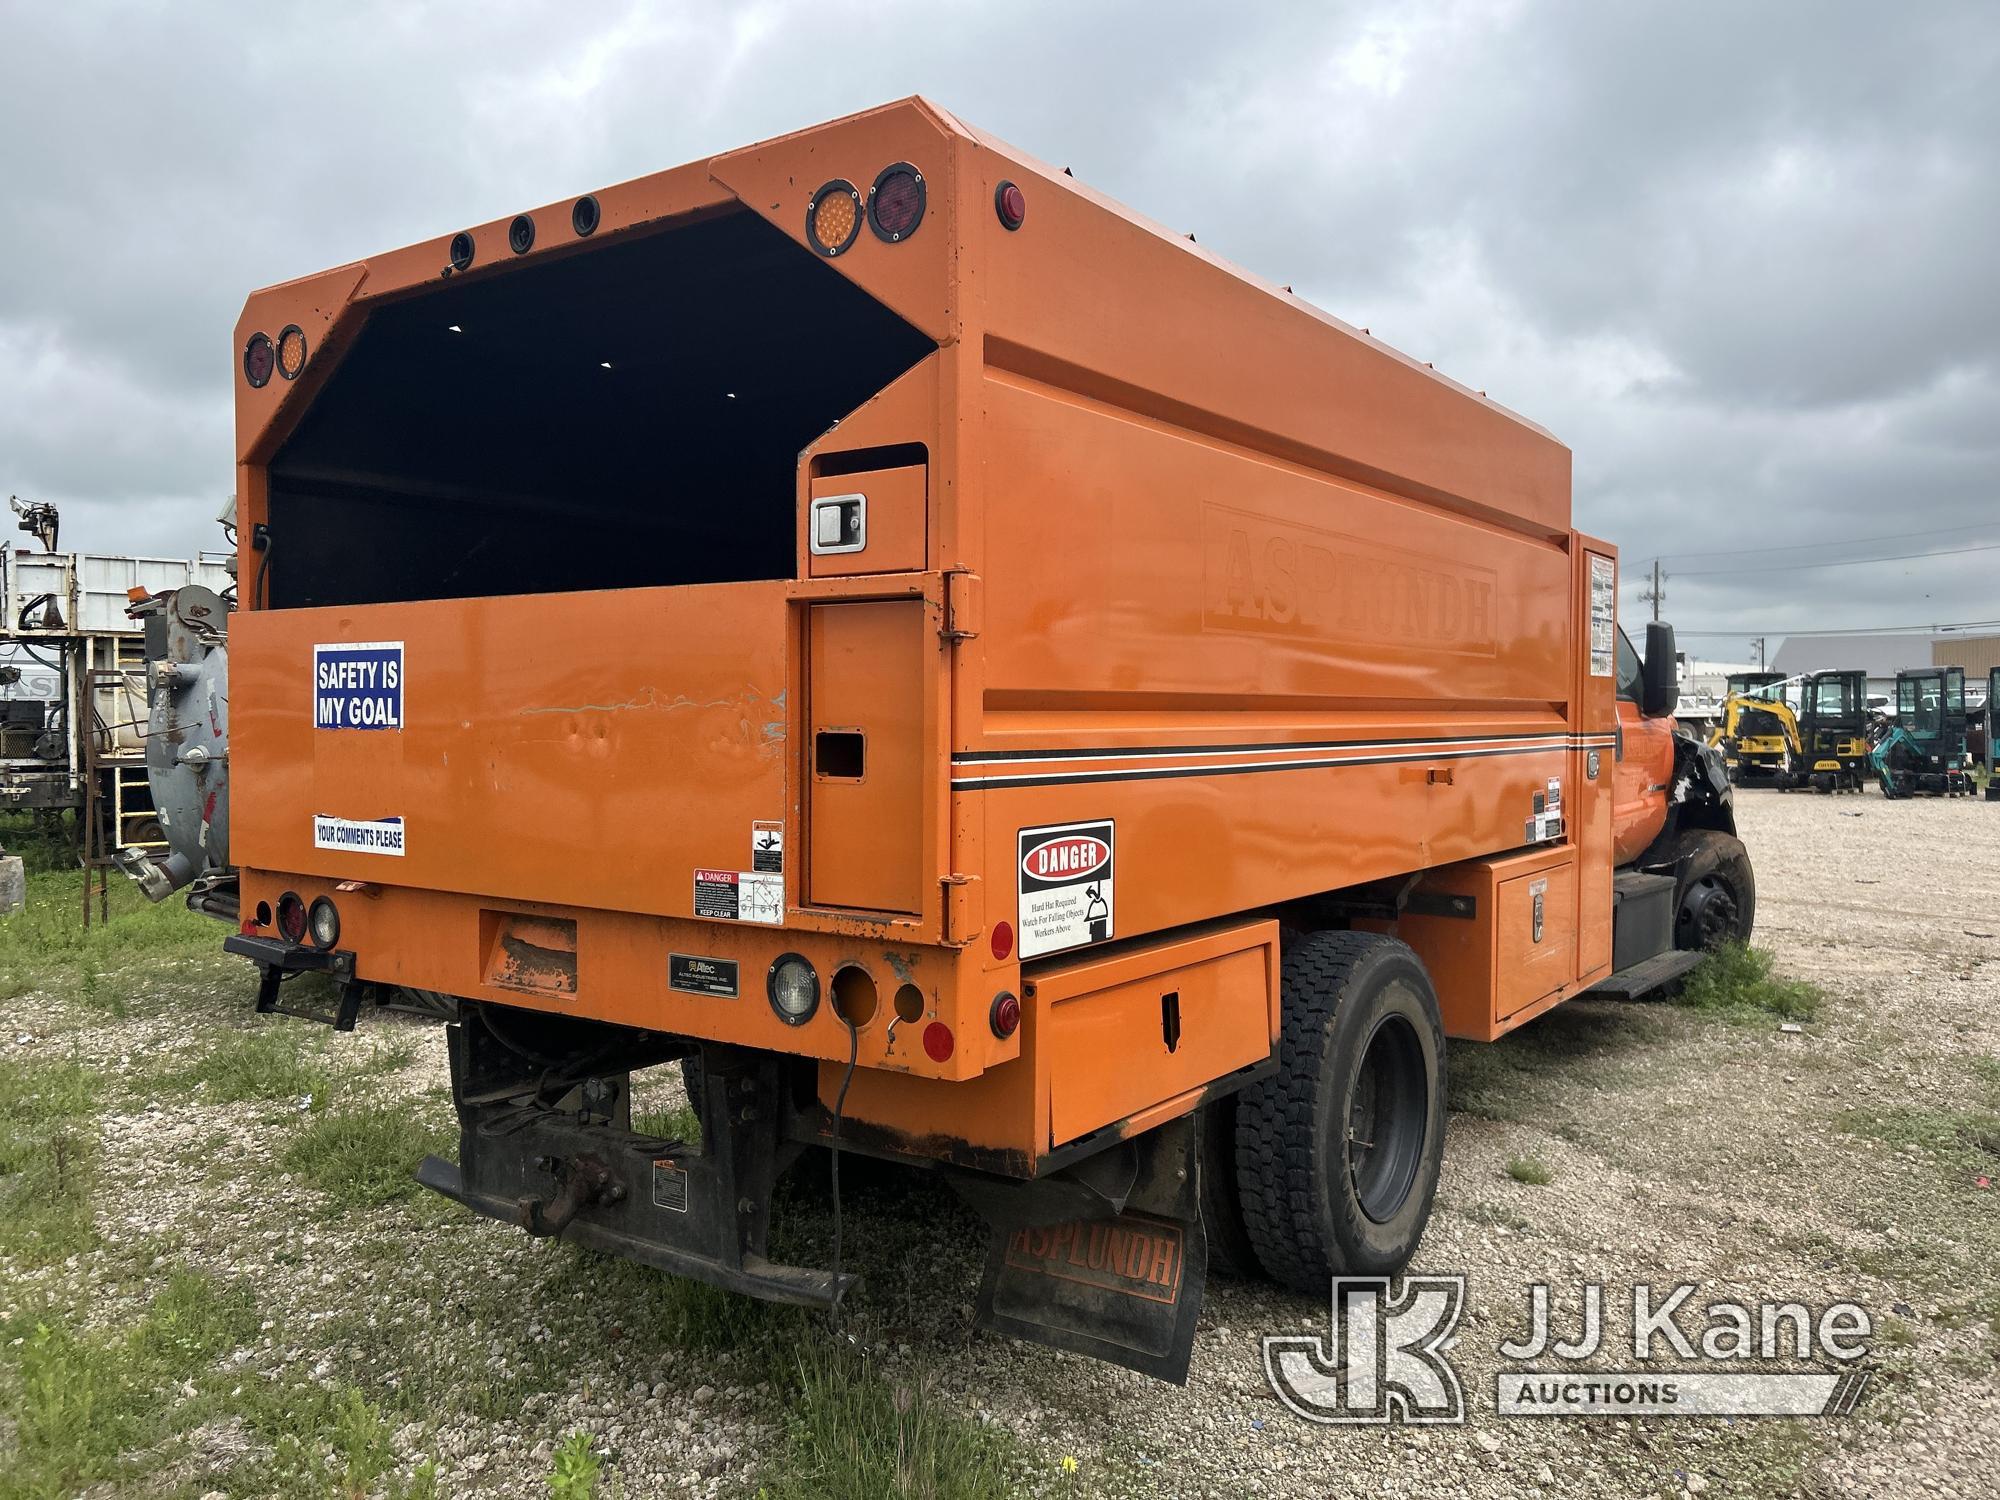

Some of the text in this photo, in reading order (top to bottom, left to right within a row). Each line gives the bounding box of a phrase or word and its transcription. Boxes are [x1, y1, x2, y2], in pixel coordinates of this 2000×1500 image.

[319, 660, 398, 690] SAFETY IS
[319, 697, 398, 725] MY GOAL
[318, 825, 402, 848] YOUR COMMENTS PLEASE
[1038, 842, 1097, 875] DANGER
[704, 872, 732, 882] DANGER
[700, 909, 731, 918] KEEP CLEAR
[1031, 896, 1077, 913] Hard Hat Required
[1022, 909, 1084, 927] Watch For Falling Objects
[1034, 925, 1071, 938] Workers Above
